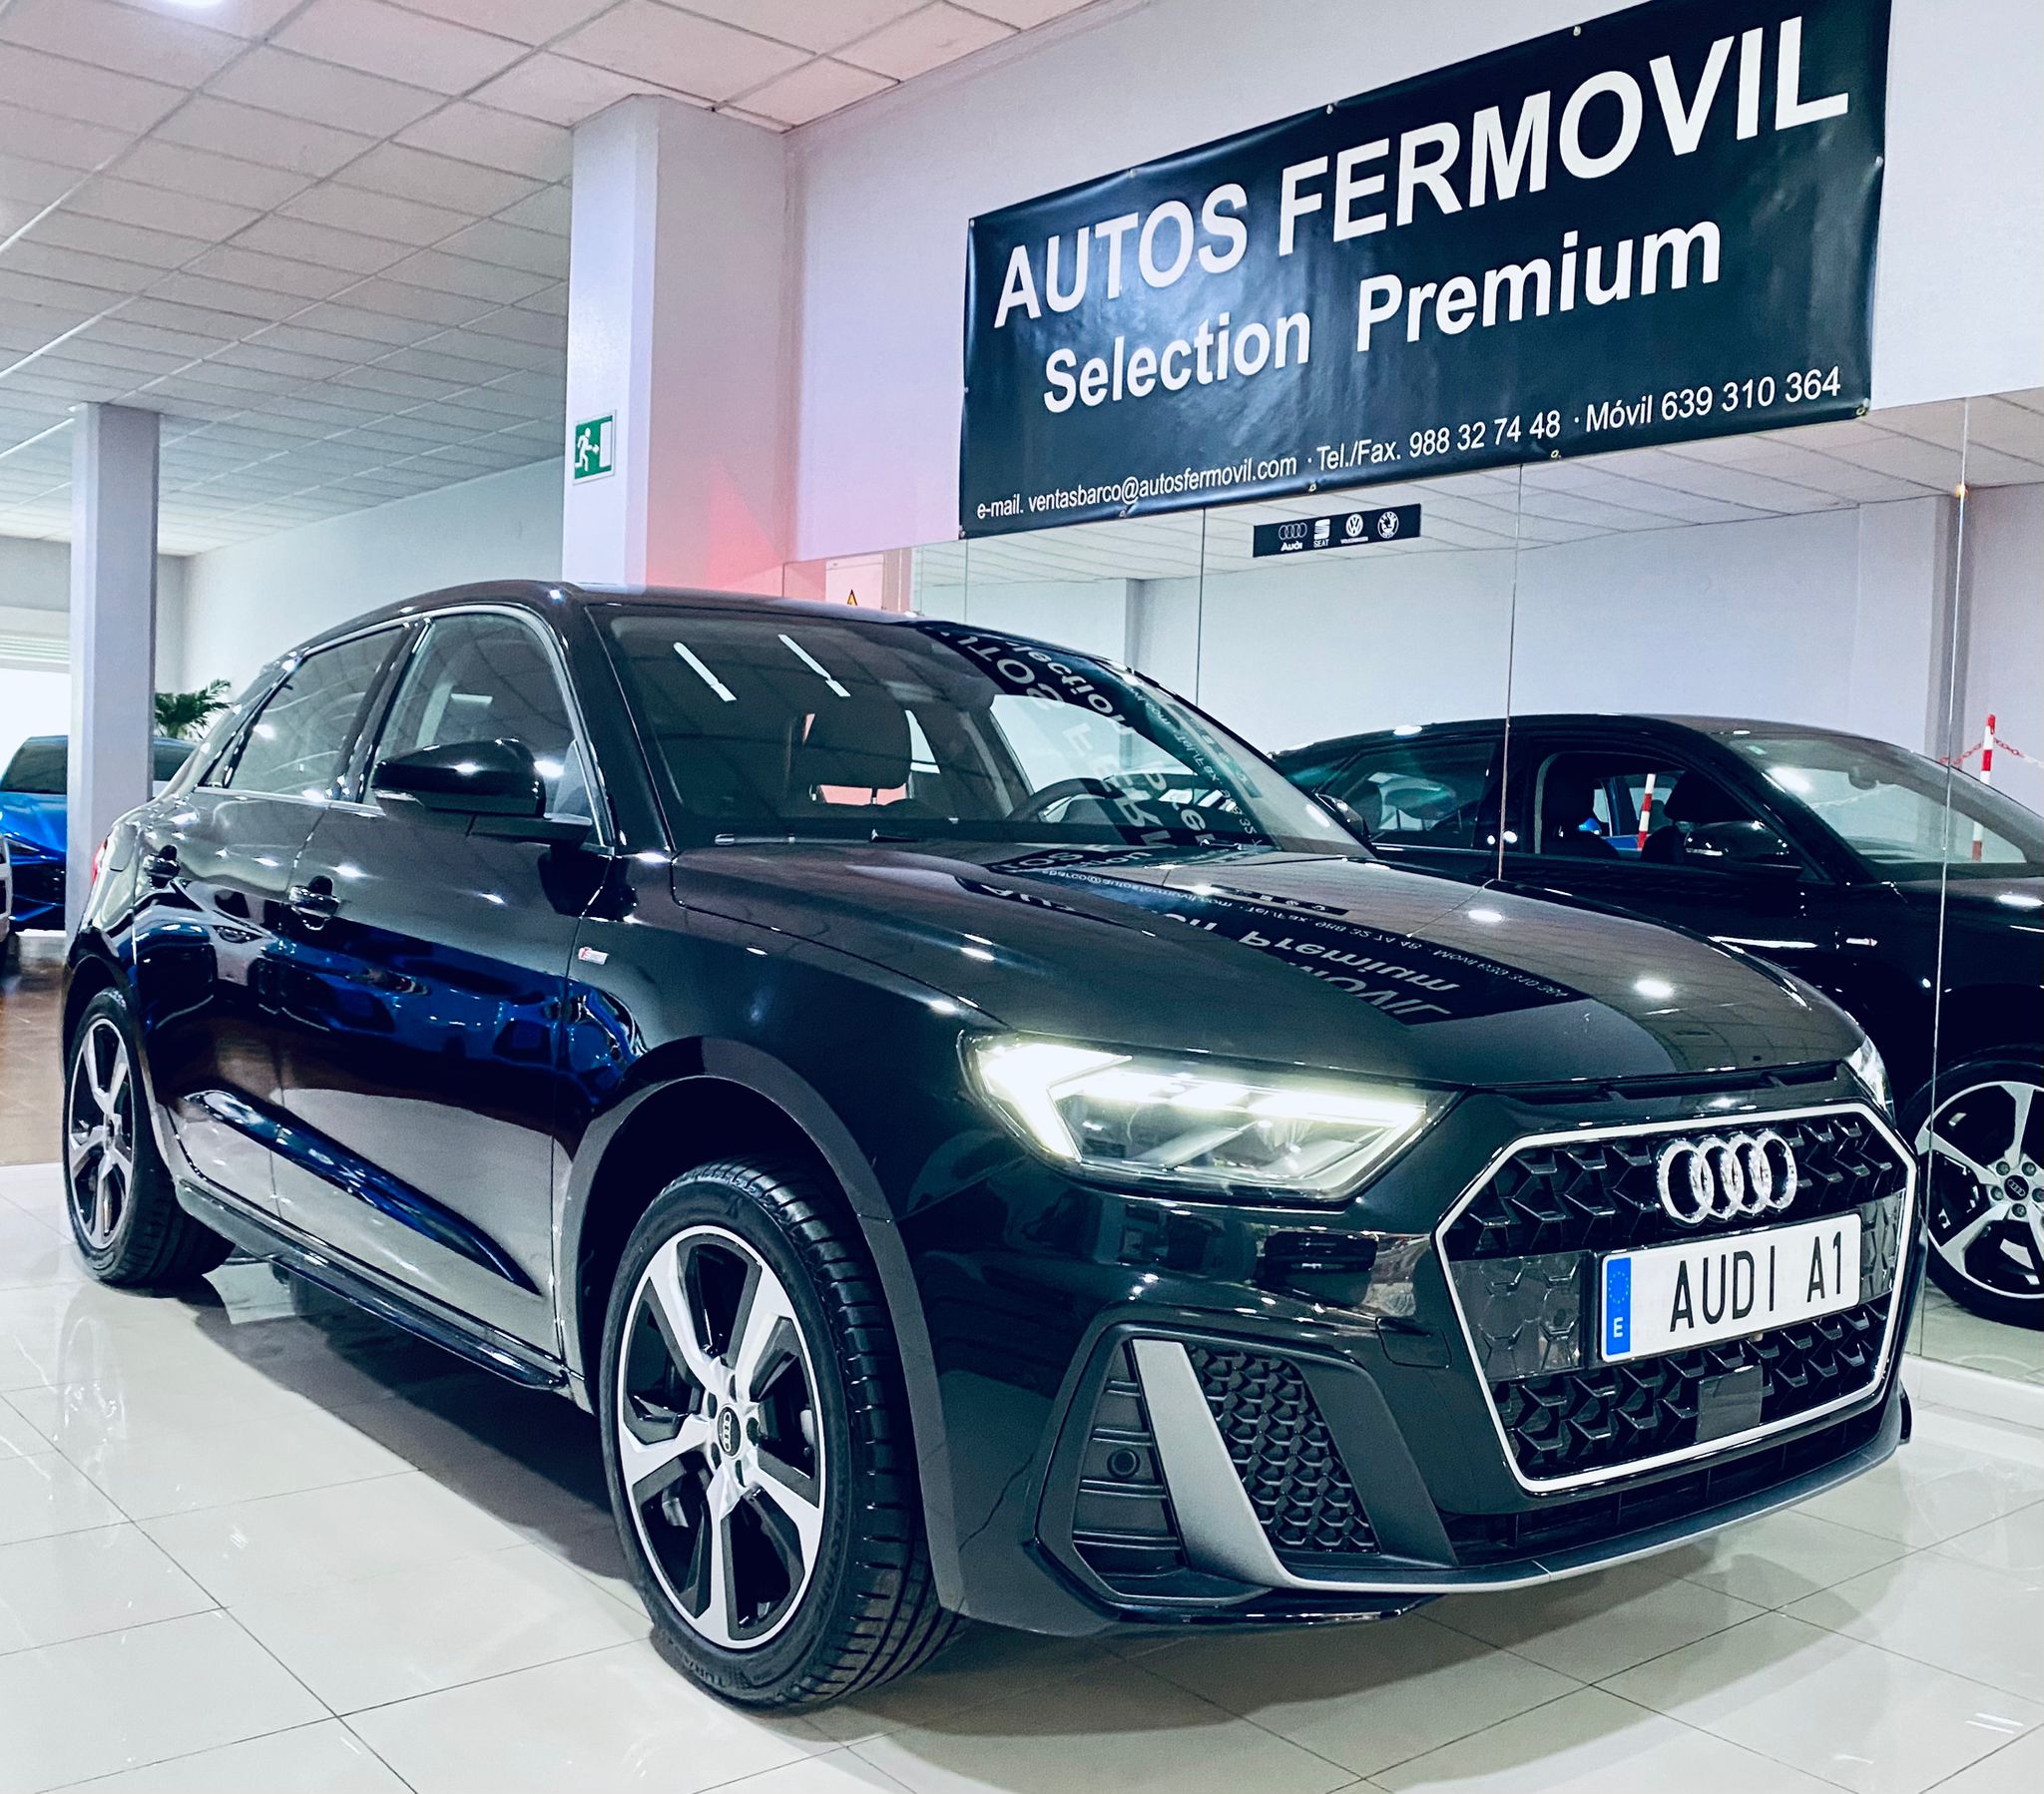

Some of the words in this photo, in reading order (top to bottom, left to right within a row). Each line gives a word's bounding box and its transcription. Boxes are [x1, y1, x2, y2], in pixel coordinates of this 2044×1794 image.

[994, 184, 1248, 328] AUTOS
[1278, 16, 1849, 256] FERMOVIL
[1044, 311, 1311, 413] Selection
[1356, 221, 1721, 352] Premium
[976, 493, 1024, 520] e-mail.
[1028, 455, 1297, 513] ventasbarco@autosfermovil.com
[1316, 439, 1401, 471] Tel./Fax.
[1409, 427, 1450, 458] 988
[1457, 421, 1486, 451] 32
[1493, 415, 1522, 446] 74
[1529, 409, 1561, 439] 48
[1586, 394, 1653, 432] Móvil
[1661, 386, 1714, 421] 639
[1722, 376, 1776, 412] 310
[1785, 365, 1841, 403] 364
[1312, 539, 1329, 549] SEAT
[1613, 1316, 1624, 1338] E
[1670, 1245, 1776, 1333] AUDI
[1806, 1231, 1843, 1303] A1
